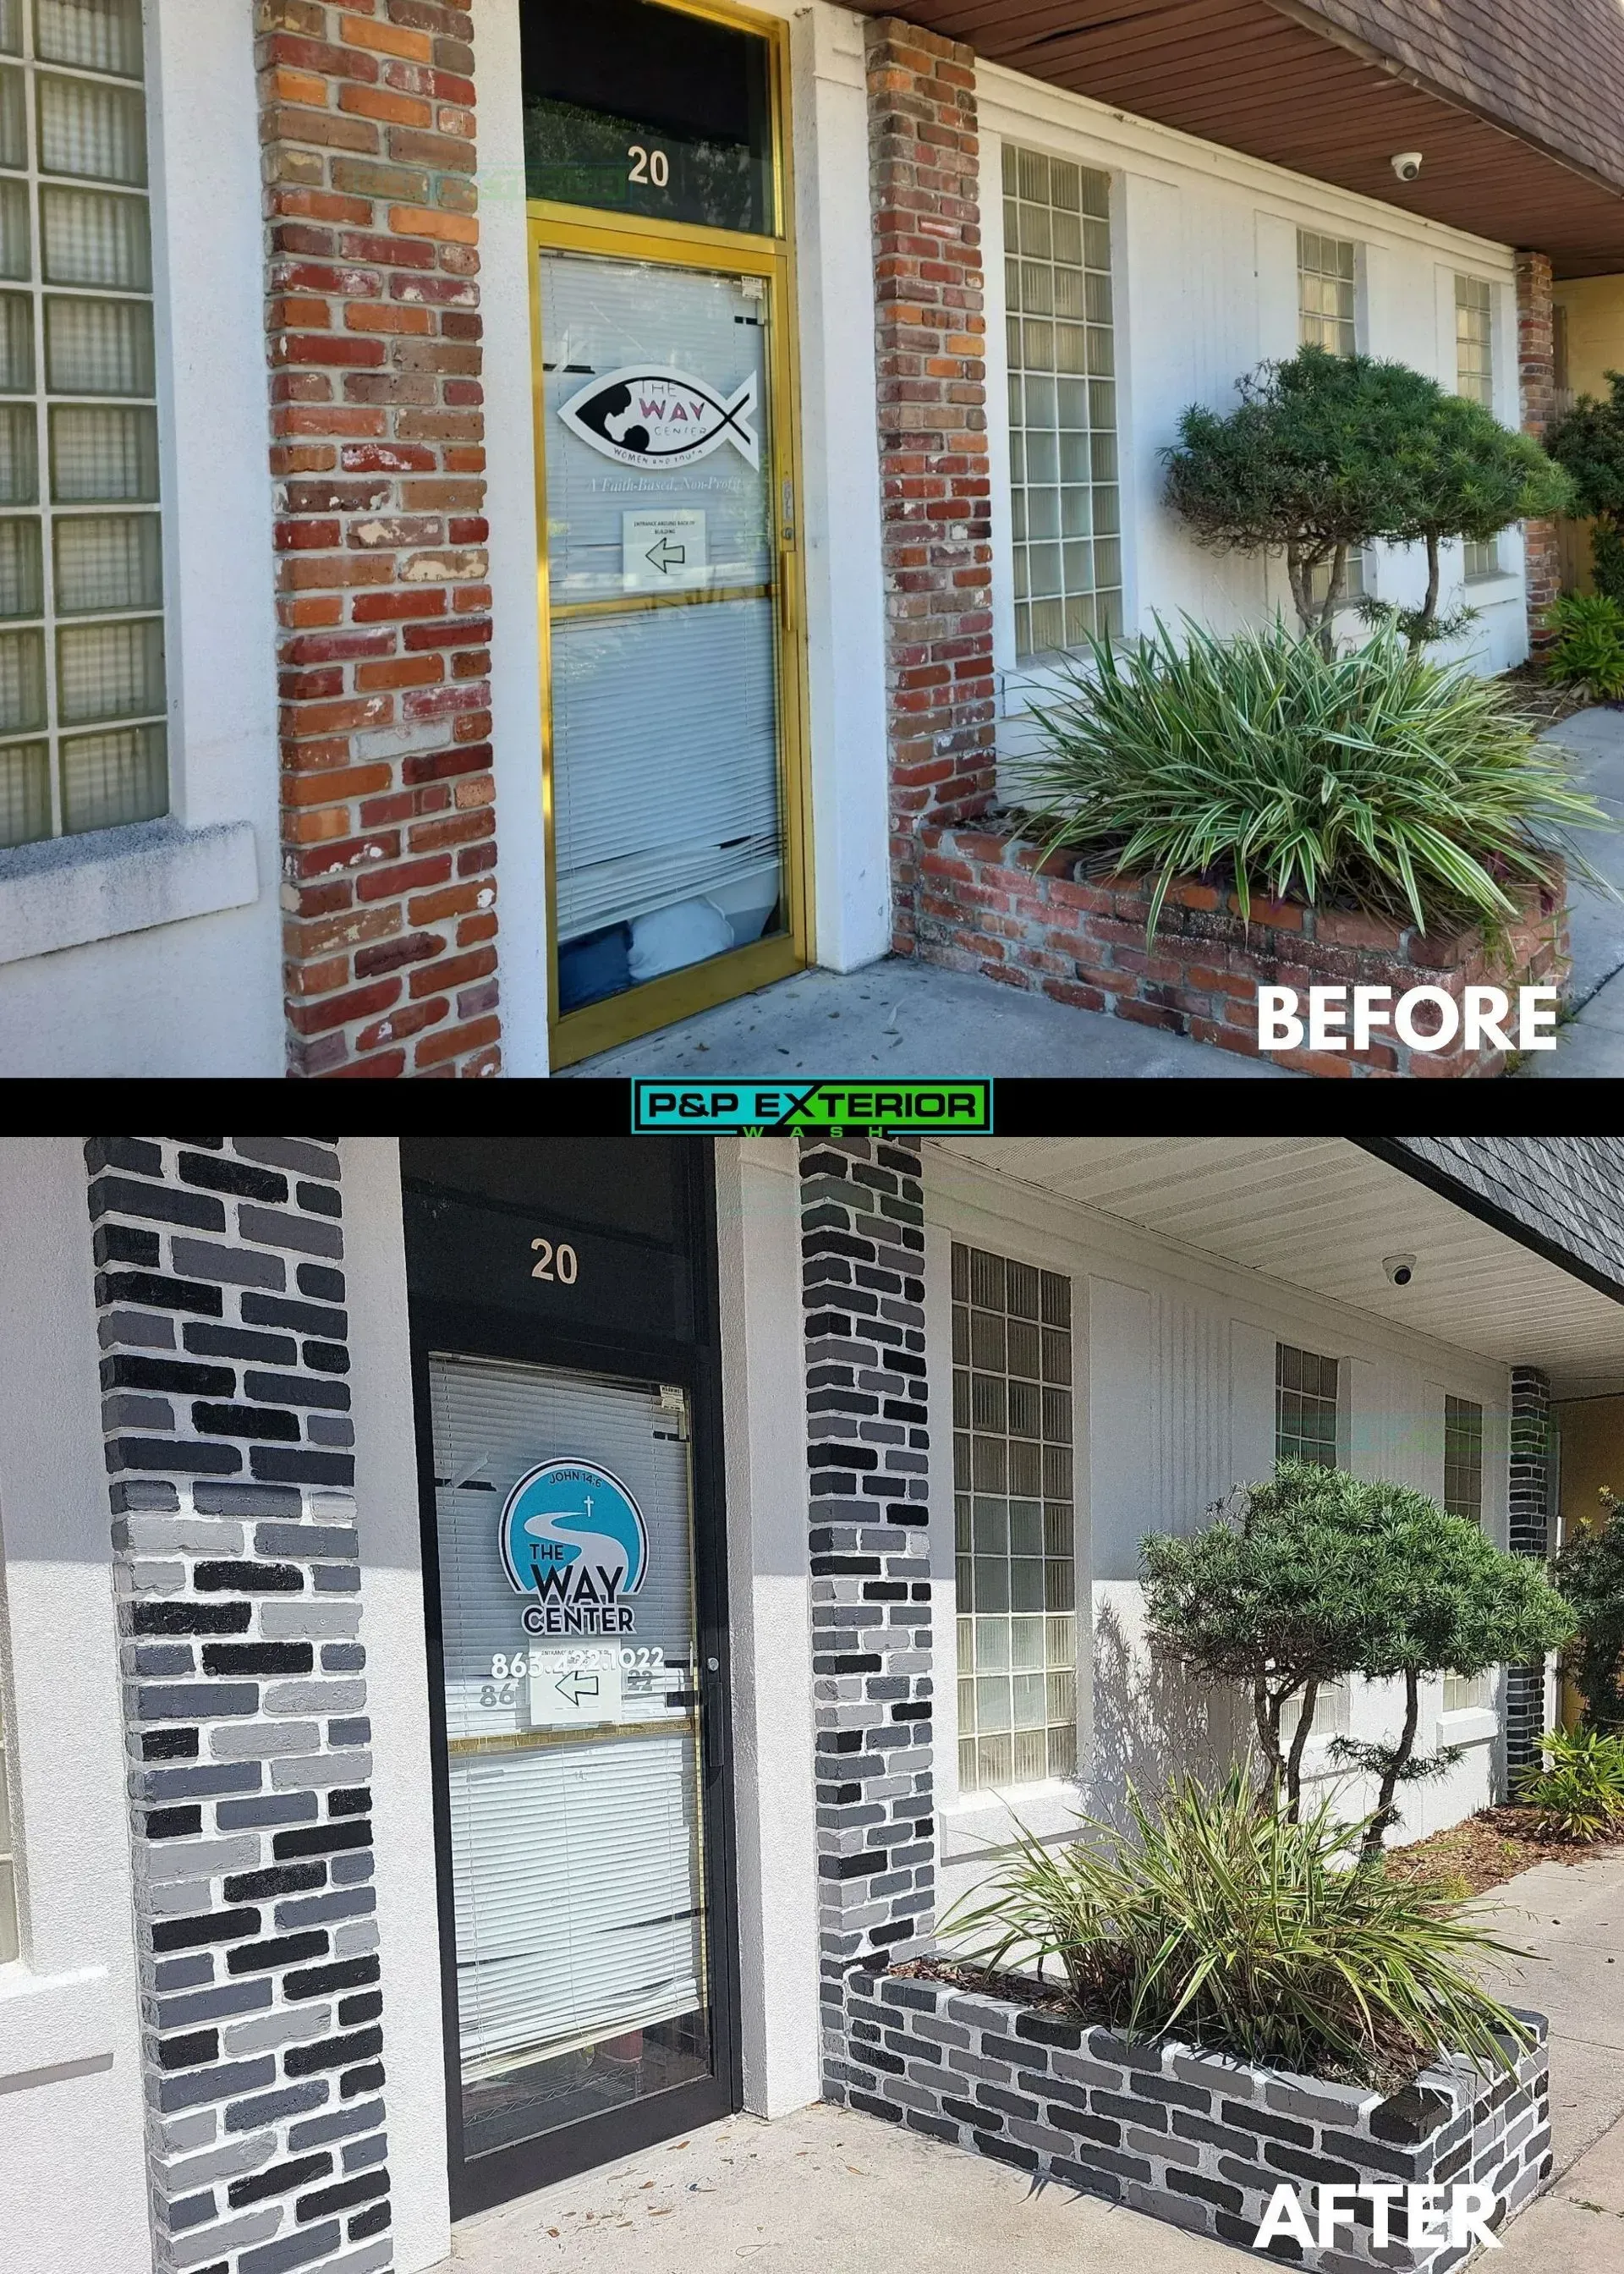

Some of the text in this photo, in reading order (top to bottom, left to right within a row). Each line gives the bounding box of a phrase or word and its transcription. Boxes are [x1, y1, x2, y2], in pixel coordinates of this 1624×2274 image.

[628, 146, 669, 187] 20
[640, 379, 677, 398] THE
[639, 398, 705, 422] WAY
[614, 448, 648, 464] WOMEN
[531, 1238, 577, 1284] 20
[549, 1471, 602, 1488] JOHN 14:6
[529, 1543, 564, 1560] THE
[529, 1563, 624, 1604] WAY
[524, 1607, 634, 1634] CENTER
